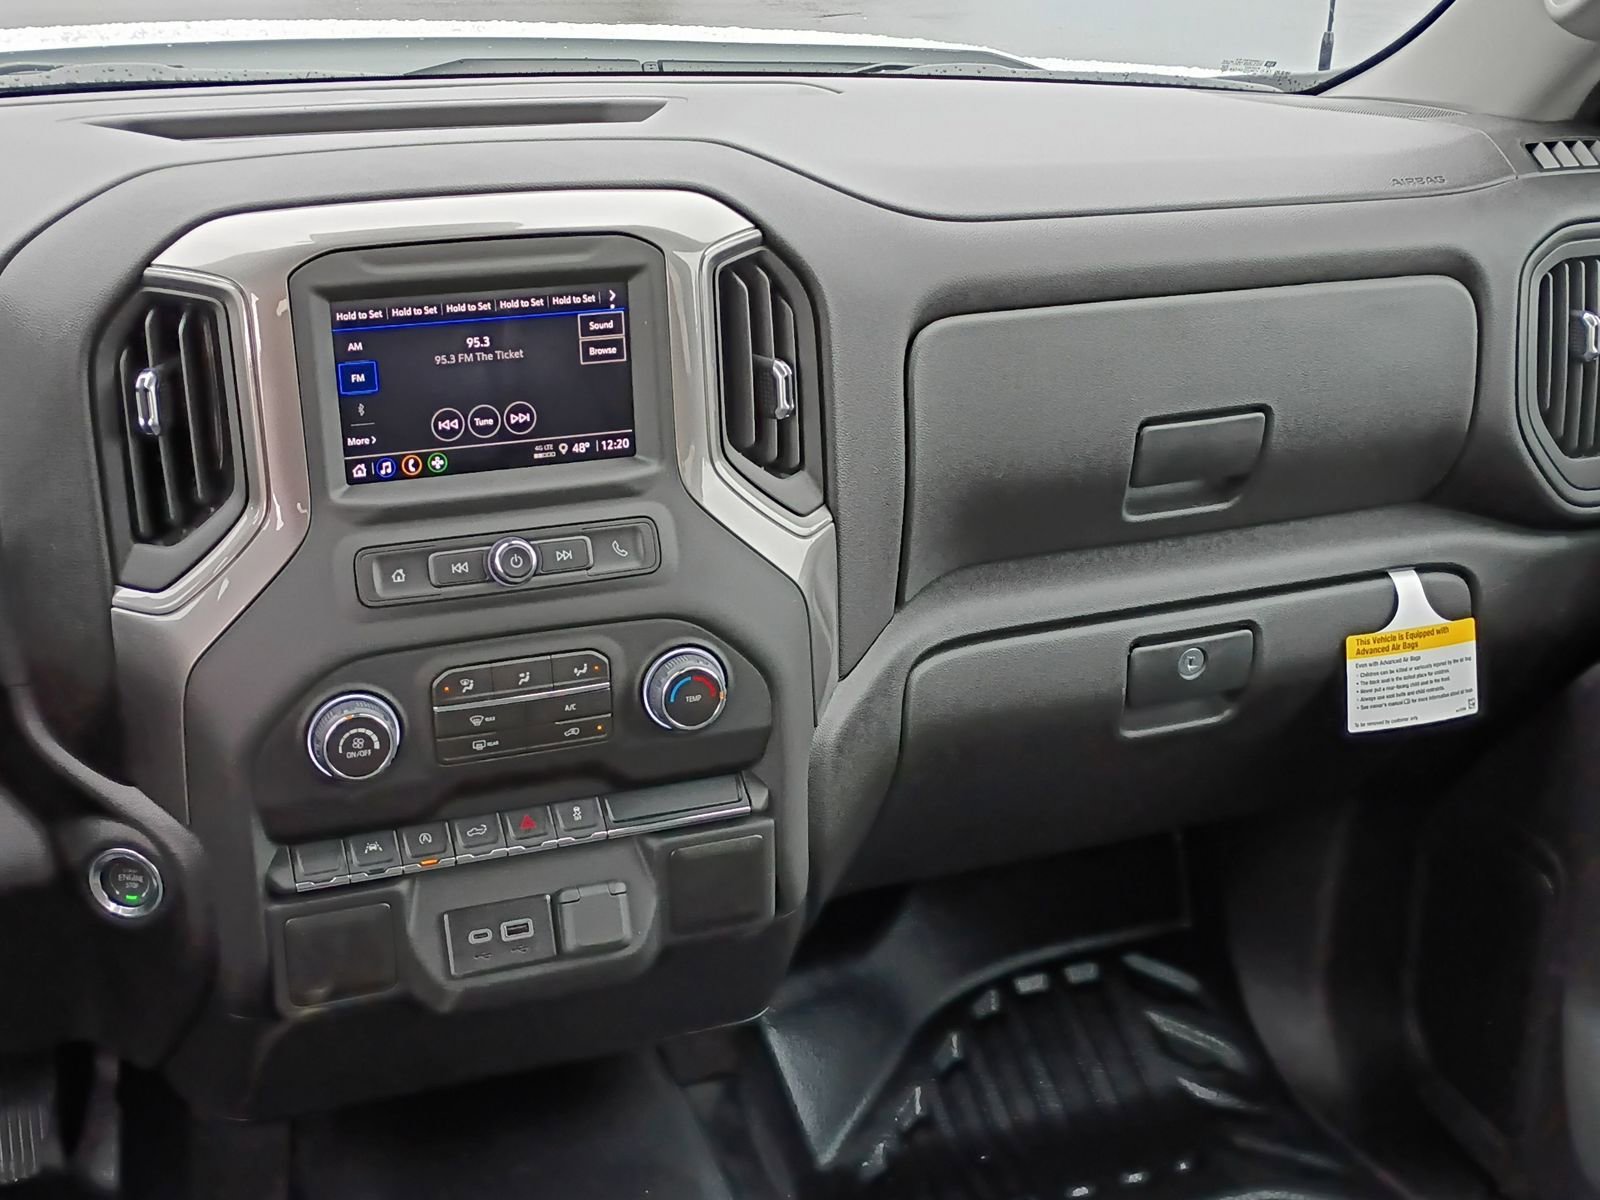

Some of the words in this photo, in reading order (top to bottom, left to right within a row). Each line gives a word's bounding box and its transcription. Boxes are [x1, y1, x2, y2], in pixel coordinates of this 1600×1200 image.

[1391, 176, 1446, 186] AIRBAG
[500, 300, 520, 309] Hold
[530, 298, 544, 307] Set
[552, 296, 572, 305] Hold
[572, 296, 581, 304] to
[582, 294, 596, 303] Set
[392, 307, 412, 317] Hold
[424, 306, 438, 315] Set
[446, 303, 466, 312] Hold
[467, 303, 476, 312] to
[478, 302, 492, 310] Set
[336, 311, 356, 321] Hold
[358, 312, 368, 320] to
[369, 310, 384, 319] Set
[589, 320, 614, 330] Sound
[348, 342, 363, 352] AM
[466, 336, 490, 348] 95.3
[589, 346, 617, 356] Browse
[434, 354, 456, 365] 95.3
[458, 353, 474, 363] FM
[476, 352, 494, 362] The
[495, 349, 524, 360] Ticket
[351, 374, 366, 383] FM
[474, 417, 494, 426] Tune
[347, 437, 370, 446] More
[601, 438, 630, 450] 12:20
[1372, 634, 1397, 644] Vehicle
[1406, 629, 1434, 640] Equipped
[1436, 626, 1449, 634] with
[1356, 644, 1390, 656] Advanced
[1402, 642, 1418, 650] Bags
[685, 694, 702, 702] TEMP
[564, 703, 577, 712] A/C
[346, 749, 372, 759] ON/OFF
